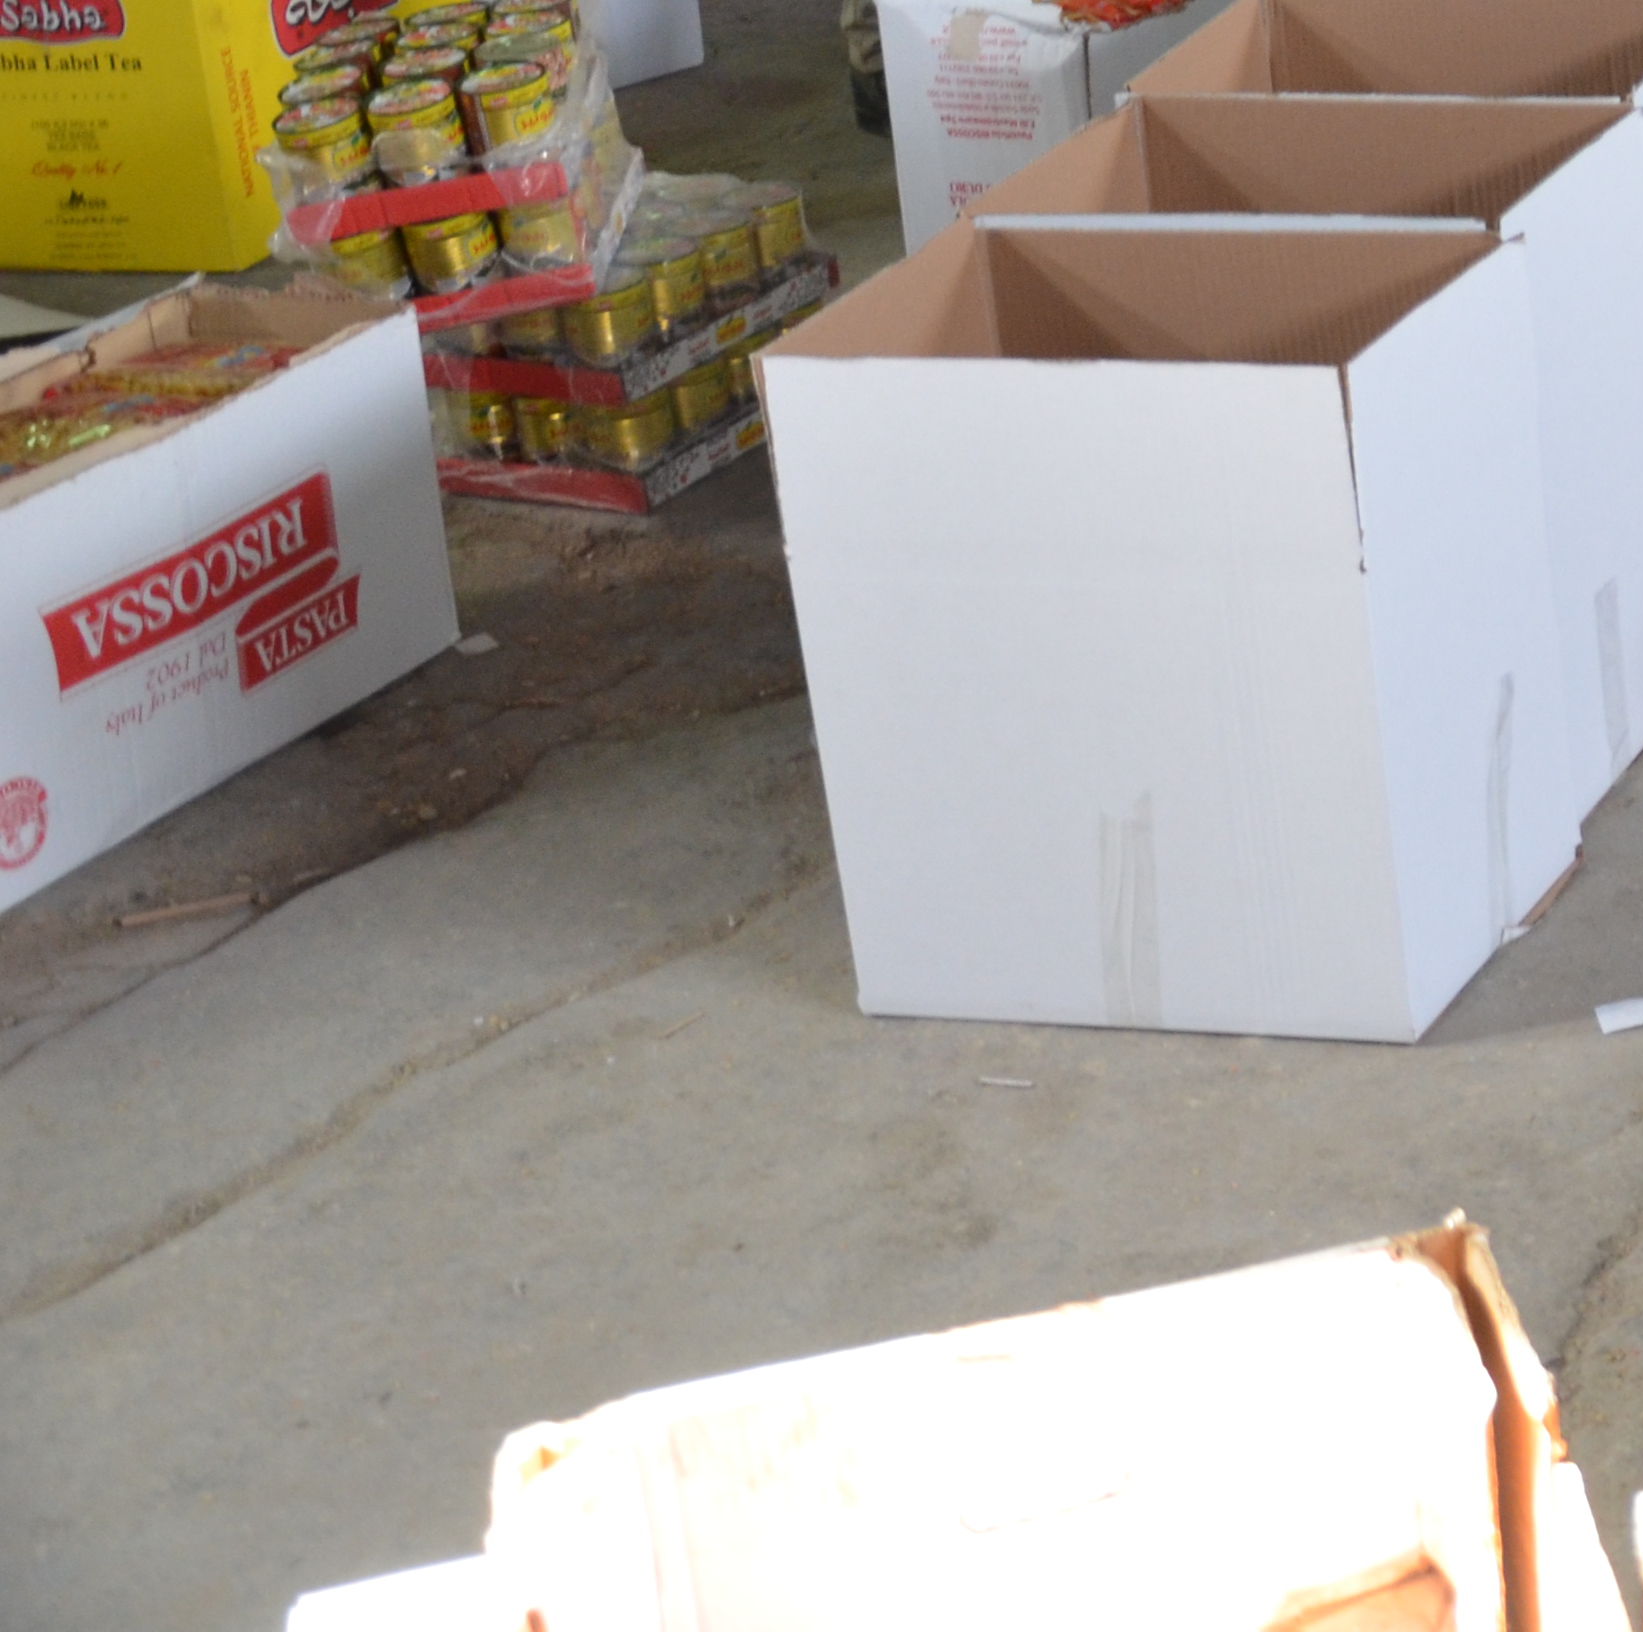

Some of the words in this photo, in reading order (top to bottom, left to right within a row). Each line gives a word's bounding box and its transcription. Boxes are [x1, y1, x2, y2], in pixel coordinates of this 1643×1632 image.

[0, 53, 37, 71] bha
[44, 54, 100, 71] Label
[104, 53, 142, 71] Tea
[71, 497, 308, 661] RISCOSSA
[199, 631, 227, 661] Dal
[254, 590, 350, 673] PASTA
[146, 652, 190, 691] 1902
[173, 658, 230, 699] Product
[149, 689, 166, 713] of
[106, 703, 143, 735] Italy
